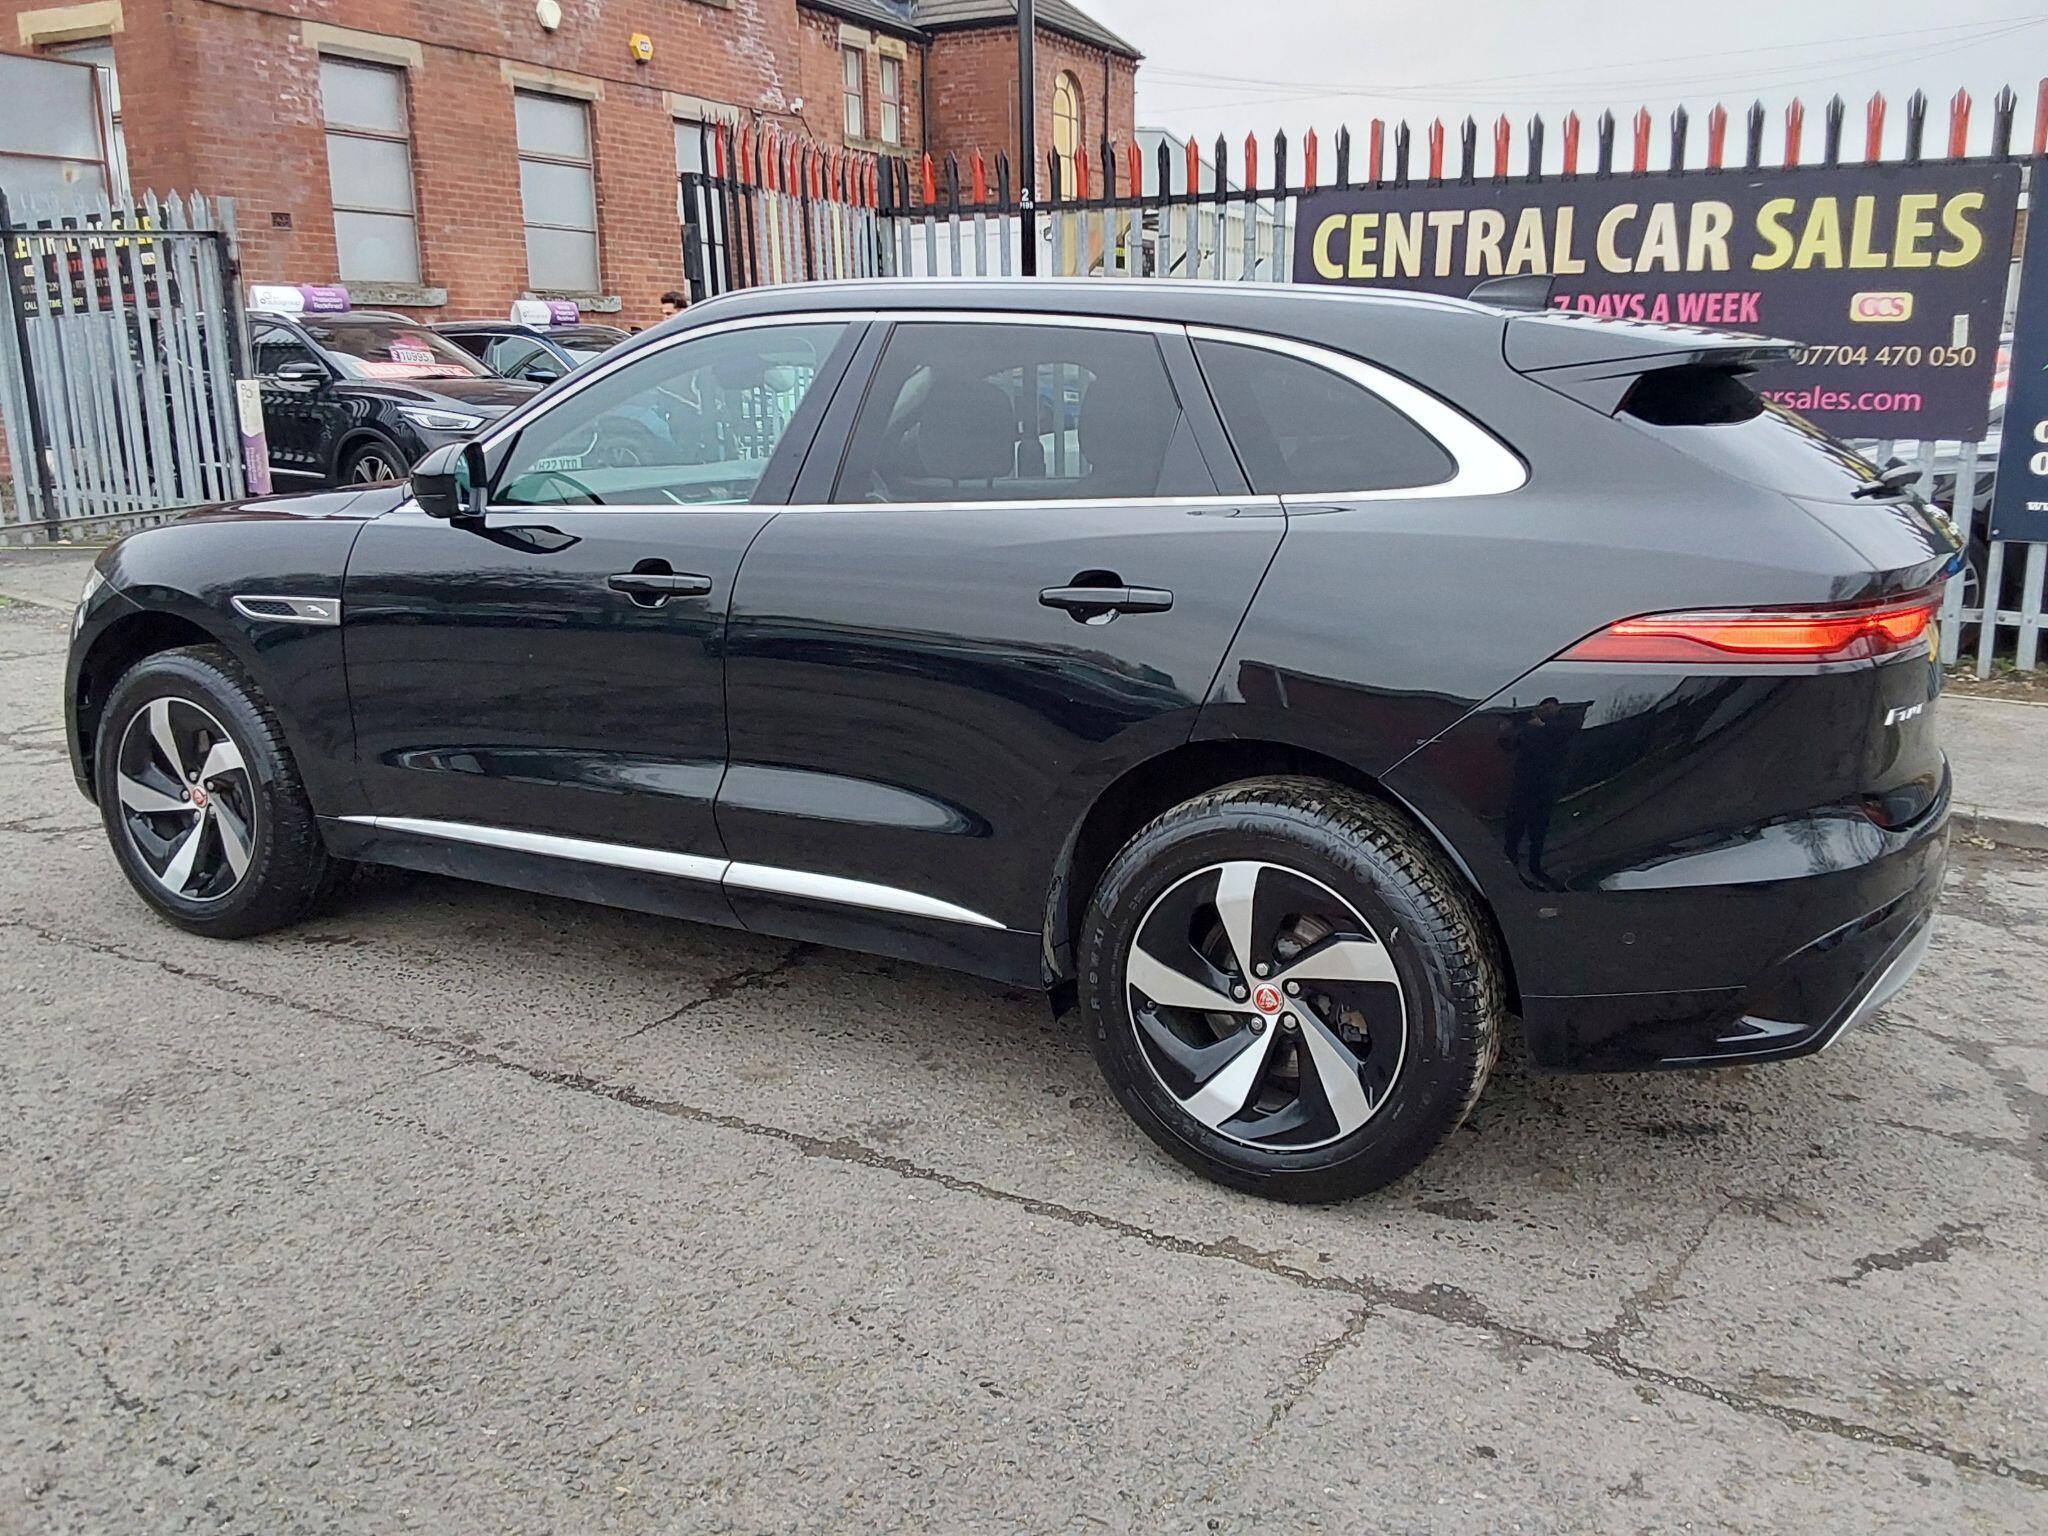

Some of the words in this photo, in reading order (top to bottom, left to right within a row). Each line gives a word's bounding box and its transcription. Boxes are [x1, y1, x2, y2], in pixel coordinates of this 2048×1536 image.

[1021, 187, 1029, 201] 2
[1312, 212, 1586, 279] CENTRAL
[1599, 201, 1735, 274] CAR
[1752, 192, 1985, 273] SALES
[1554, 295, 1571, 311] 7
[1577, 293, 1646, 320] DAYS
[1650, 293, 1670, 323] A
[1676, 292, 1762, 323] WEEK
[1875, 344, 1922, 367] 470
[1928, 344, 1977, 367] 050
